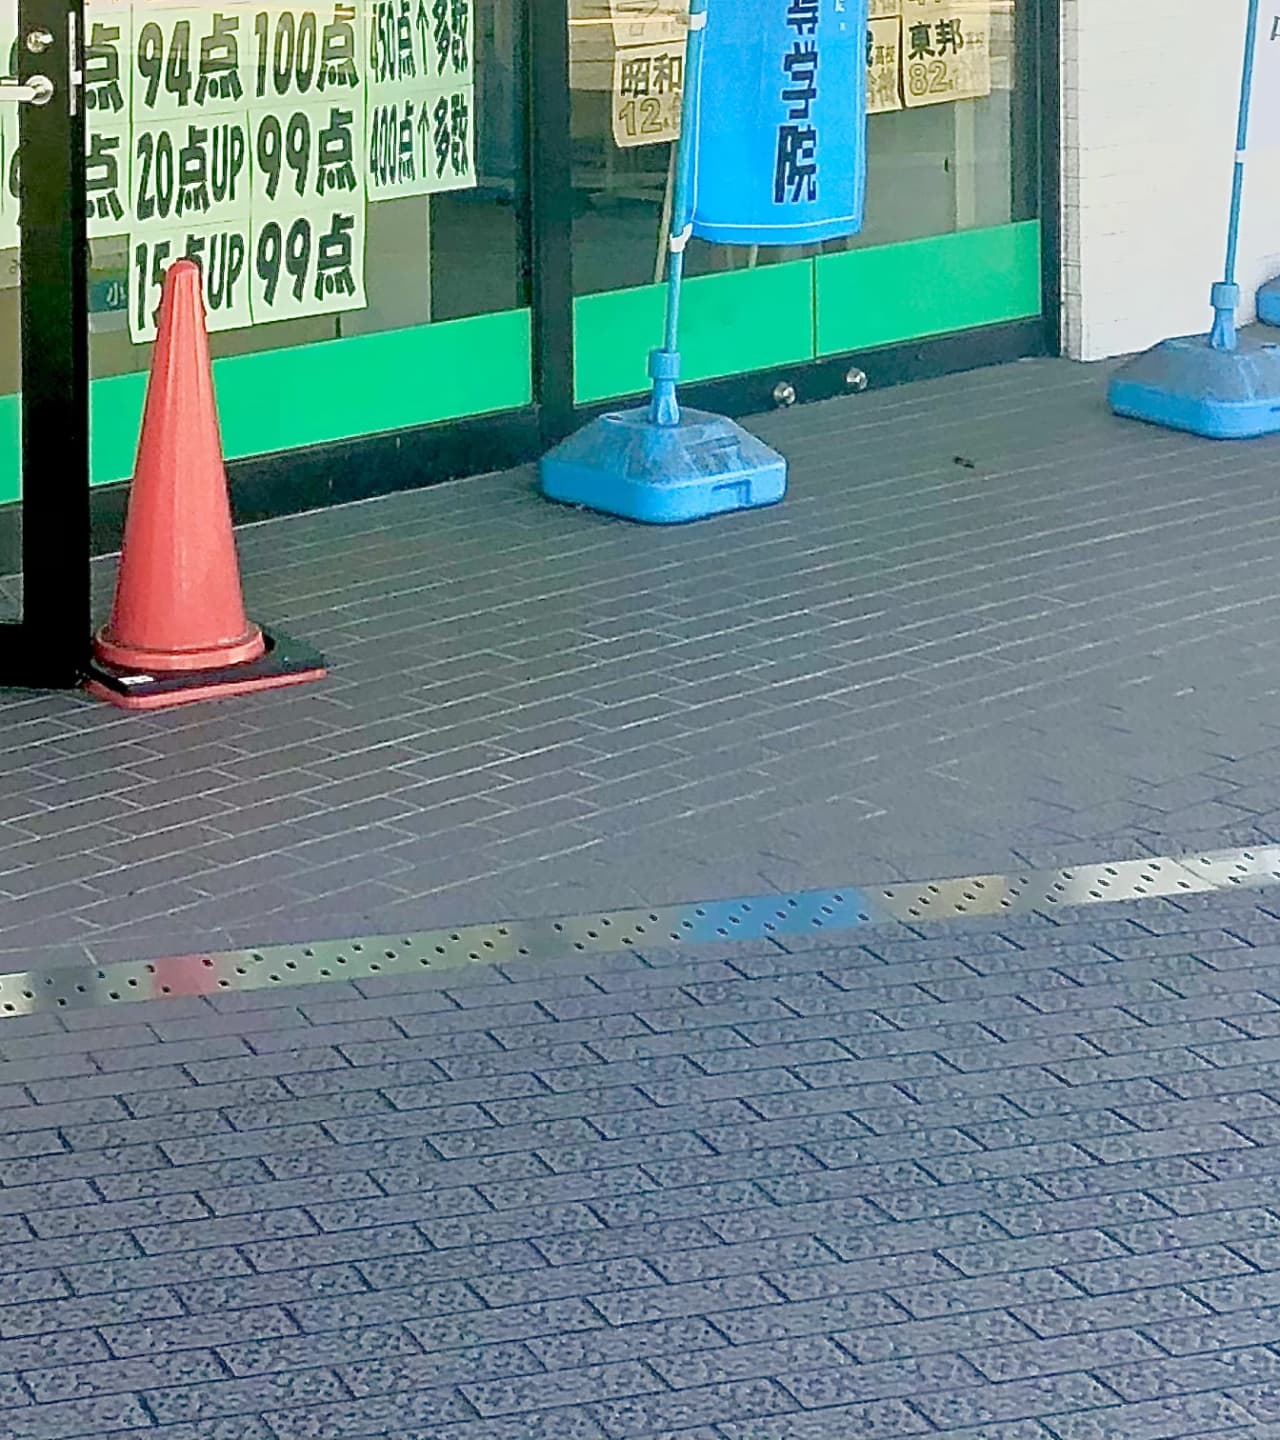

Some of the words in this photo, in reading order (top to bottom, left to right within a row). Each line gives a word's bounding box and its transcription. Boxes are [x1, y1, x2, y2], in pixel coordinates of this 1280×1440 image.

[137, 13, 243, 109] 94点
[255, 3, 360, 98] 100点
[136, 123, 246, 221] 20点UP
[255, 108, 355, 200] 99点
[134, 232, 246, 332] 15UP
[255, 212, 356, 308] 99点
